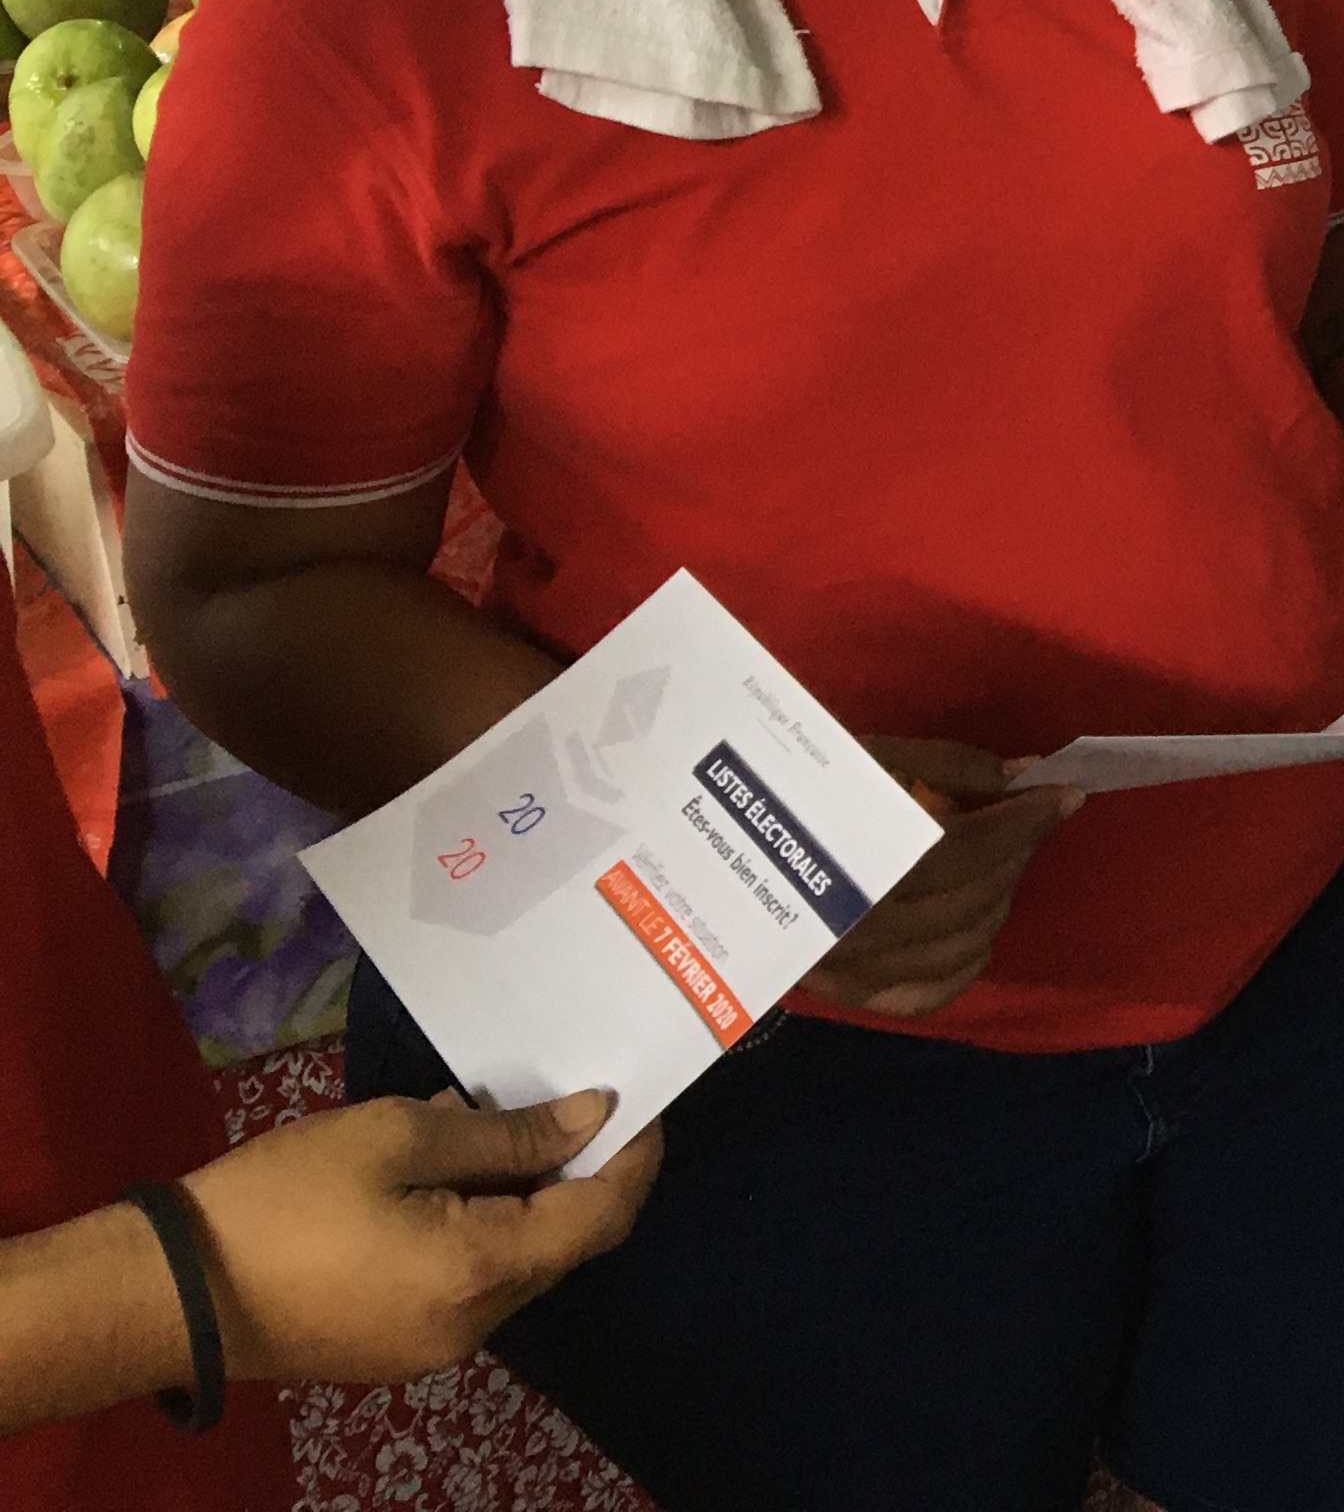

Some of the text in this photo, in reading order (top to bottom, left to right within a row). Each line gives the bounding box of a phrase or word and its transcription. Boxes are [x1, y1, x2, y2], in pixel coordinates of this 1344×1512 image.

[436, 838, 487, 880] 20
[497, 793, 546, 835] 20
[680, 795, 734, 861] Êtes-vous
[731, 852, 758, 888] bien
[704, 758, 833, 898] LISTES ÉLECTORALES
[600, 868, 651, 917] AVANT
[638, 912, 665, 936] LE
[652, 926, 671, 944] 7
[705, 991, 739, 1031] 2020
